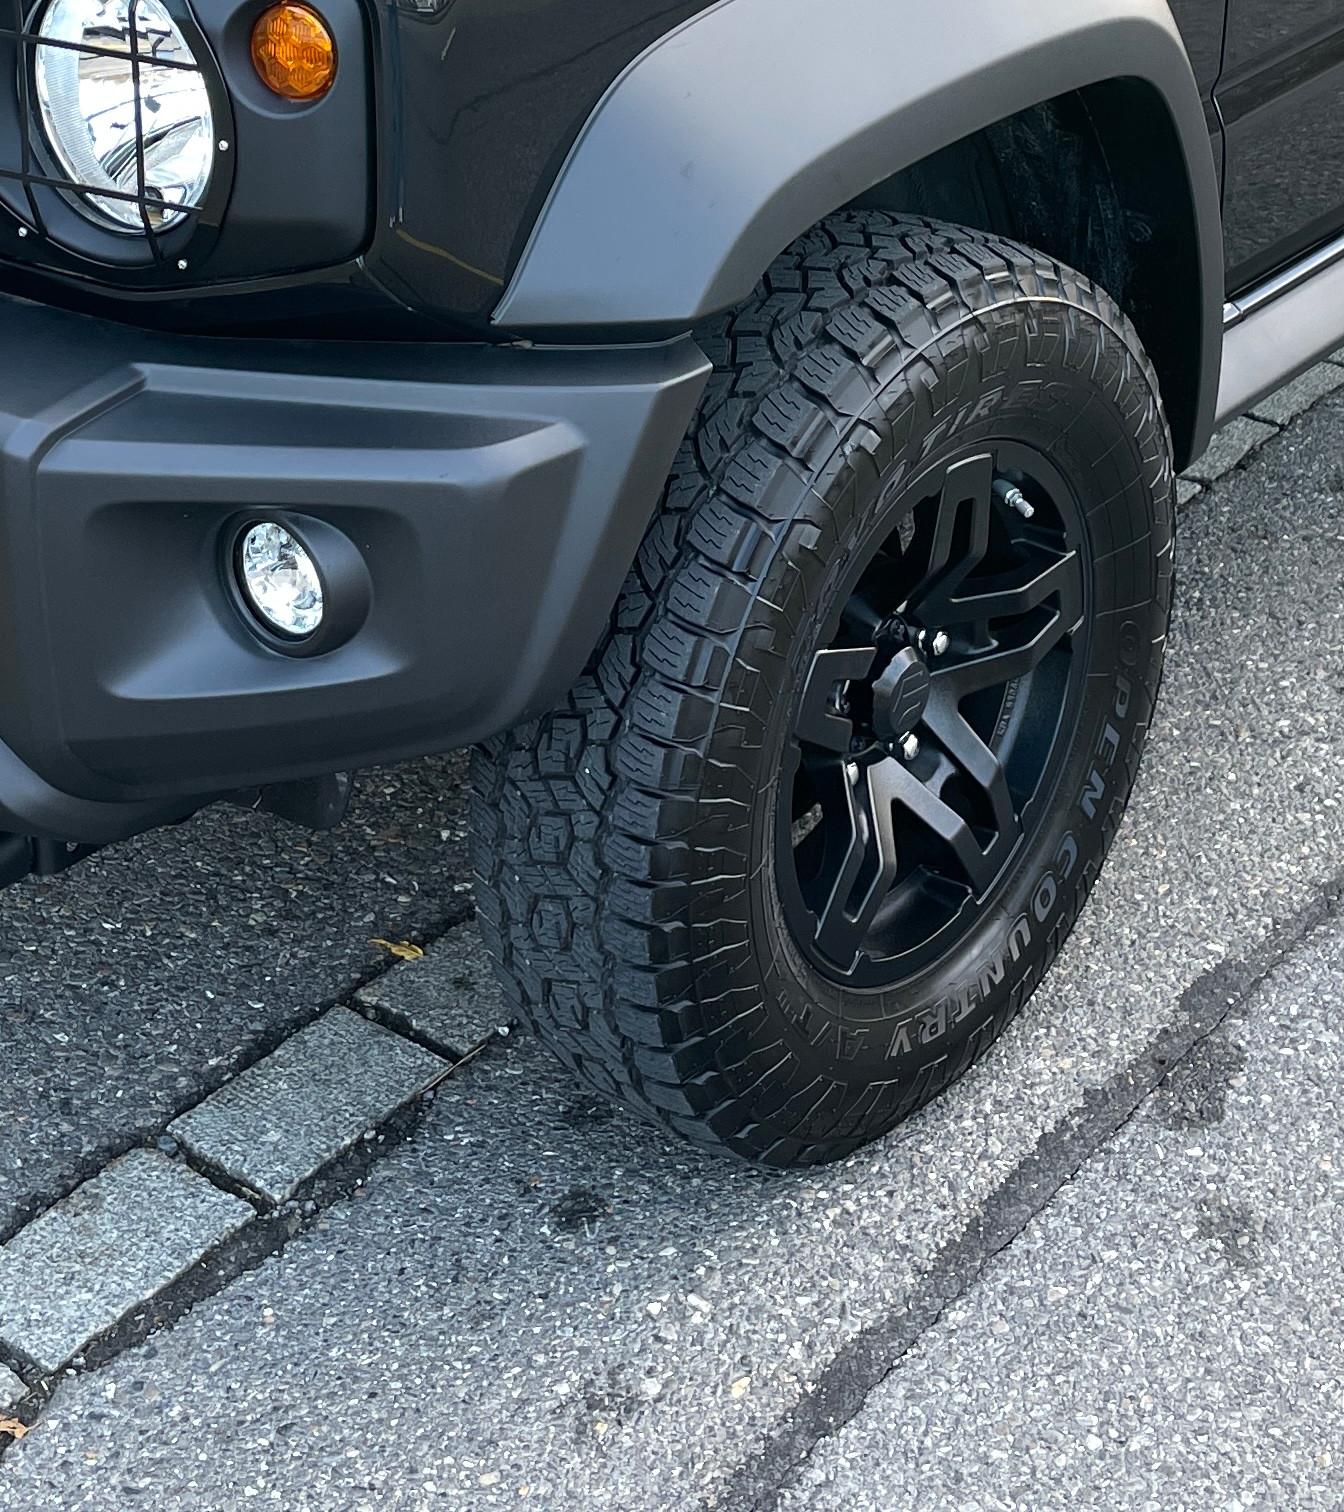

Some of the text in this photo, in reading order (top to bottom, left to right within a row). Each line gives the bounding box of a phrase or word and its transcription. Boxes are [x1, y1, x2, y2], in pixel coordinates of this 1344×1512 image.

[920, 379, 1068, 461] TIRES
[1076, 619, 1142, 822] OPEN
[884, 829, 1079, 1062] COUNTRY
